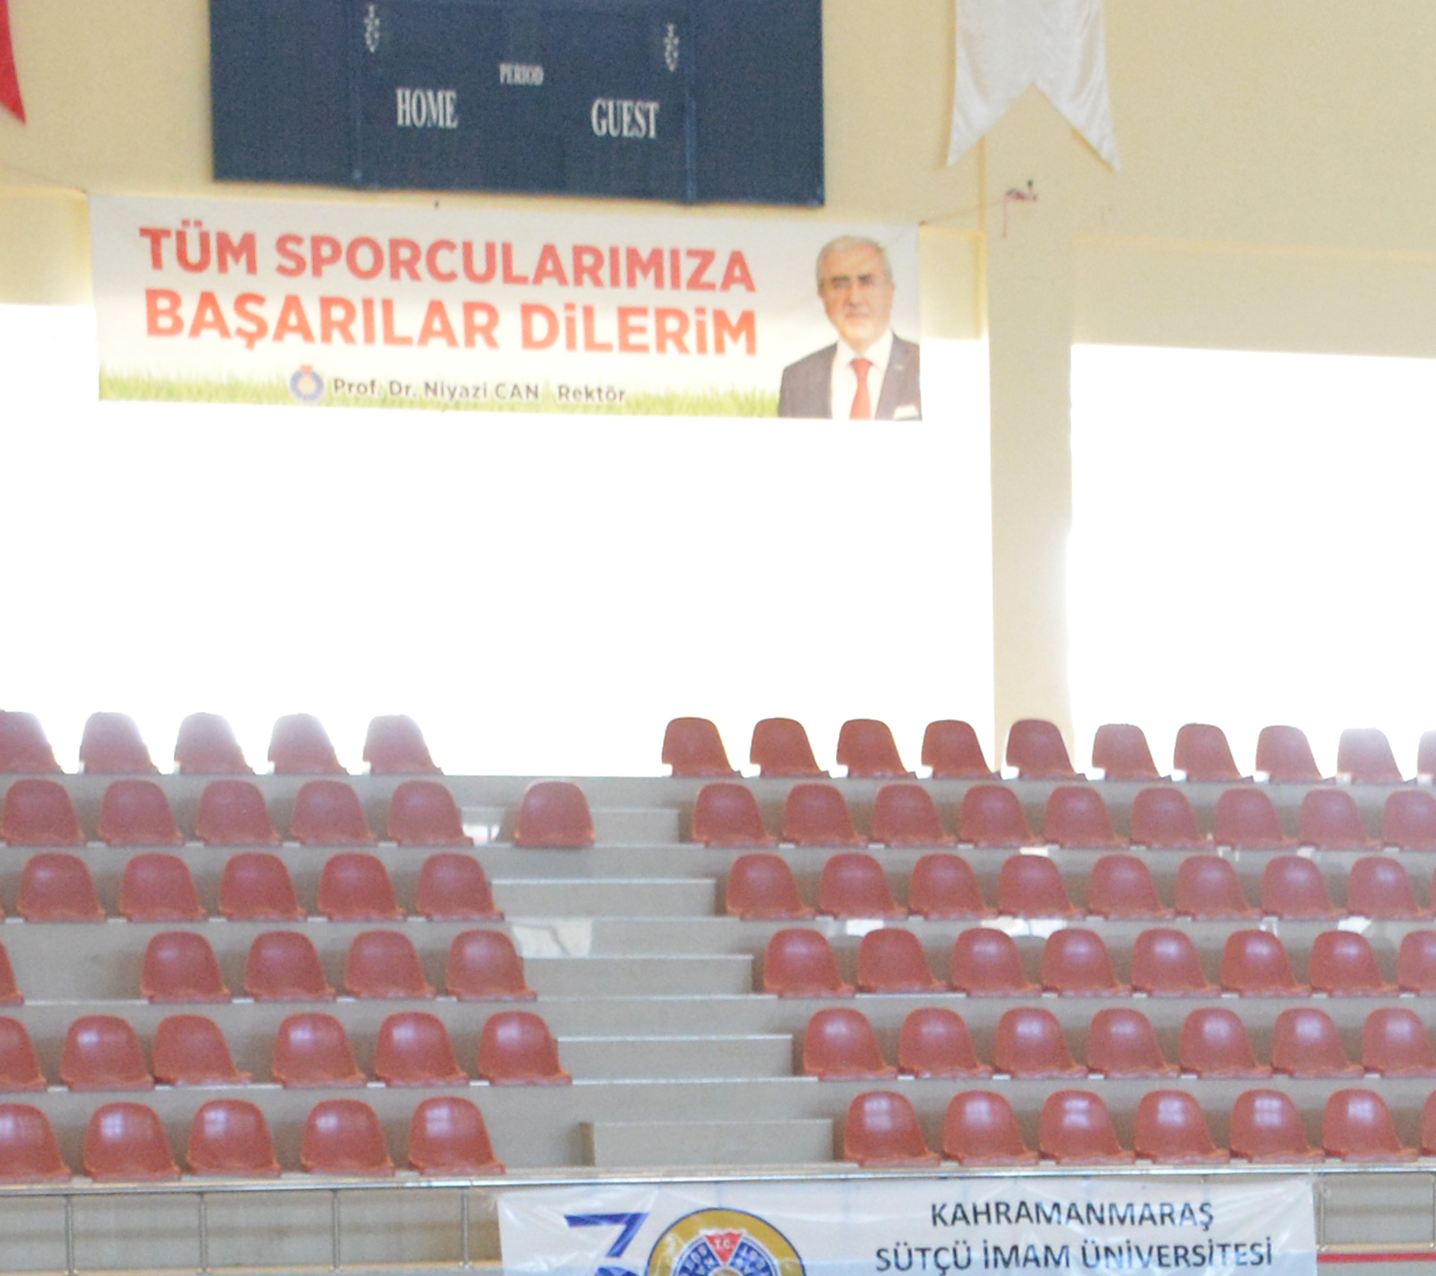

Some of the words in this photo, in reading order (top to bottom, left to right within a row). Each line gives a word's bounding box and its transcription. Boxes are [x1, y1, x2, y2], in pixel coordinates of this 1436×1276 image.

[498, 62, 544, 86] PERIOD
[395, 87, 459, 129] HOME
[590, 98, 660, 139] GUEST
[139, 218, 258, 276] TÜM
[274, 232, 757, 293] SPORCULARIMIZA
[144, 288, 501, 352] BAŞARILAR
[332, 378, 382, 397] Prof.
[389, 380, 416, 398] Dr.
[495, 383, 540, 400] CAN
[557, 383, 627, 403] Rektör
[930, 1200, 1215, 1232] KAHRAMANMARAŞ
[875, 1240, 973, 1276] SÜTÇÜ
[982, 1239, 1071, 1269] İMAM
[1081, 1236, 1273, 1269] ÜNİVERSİTESİ
